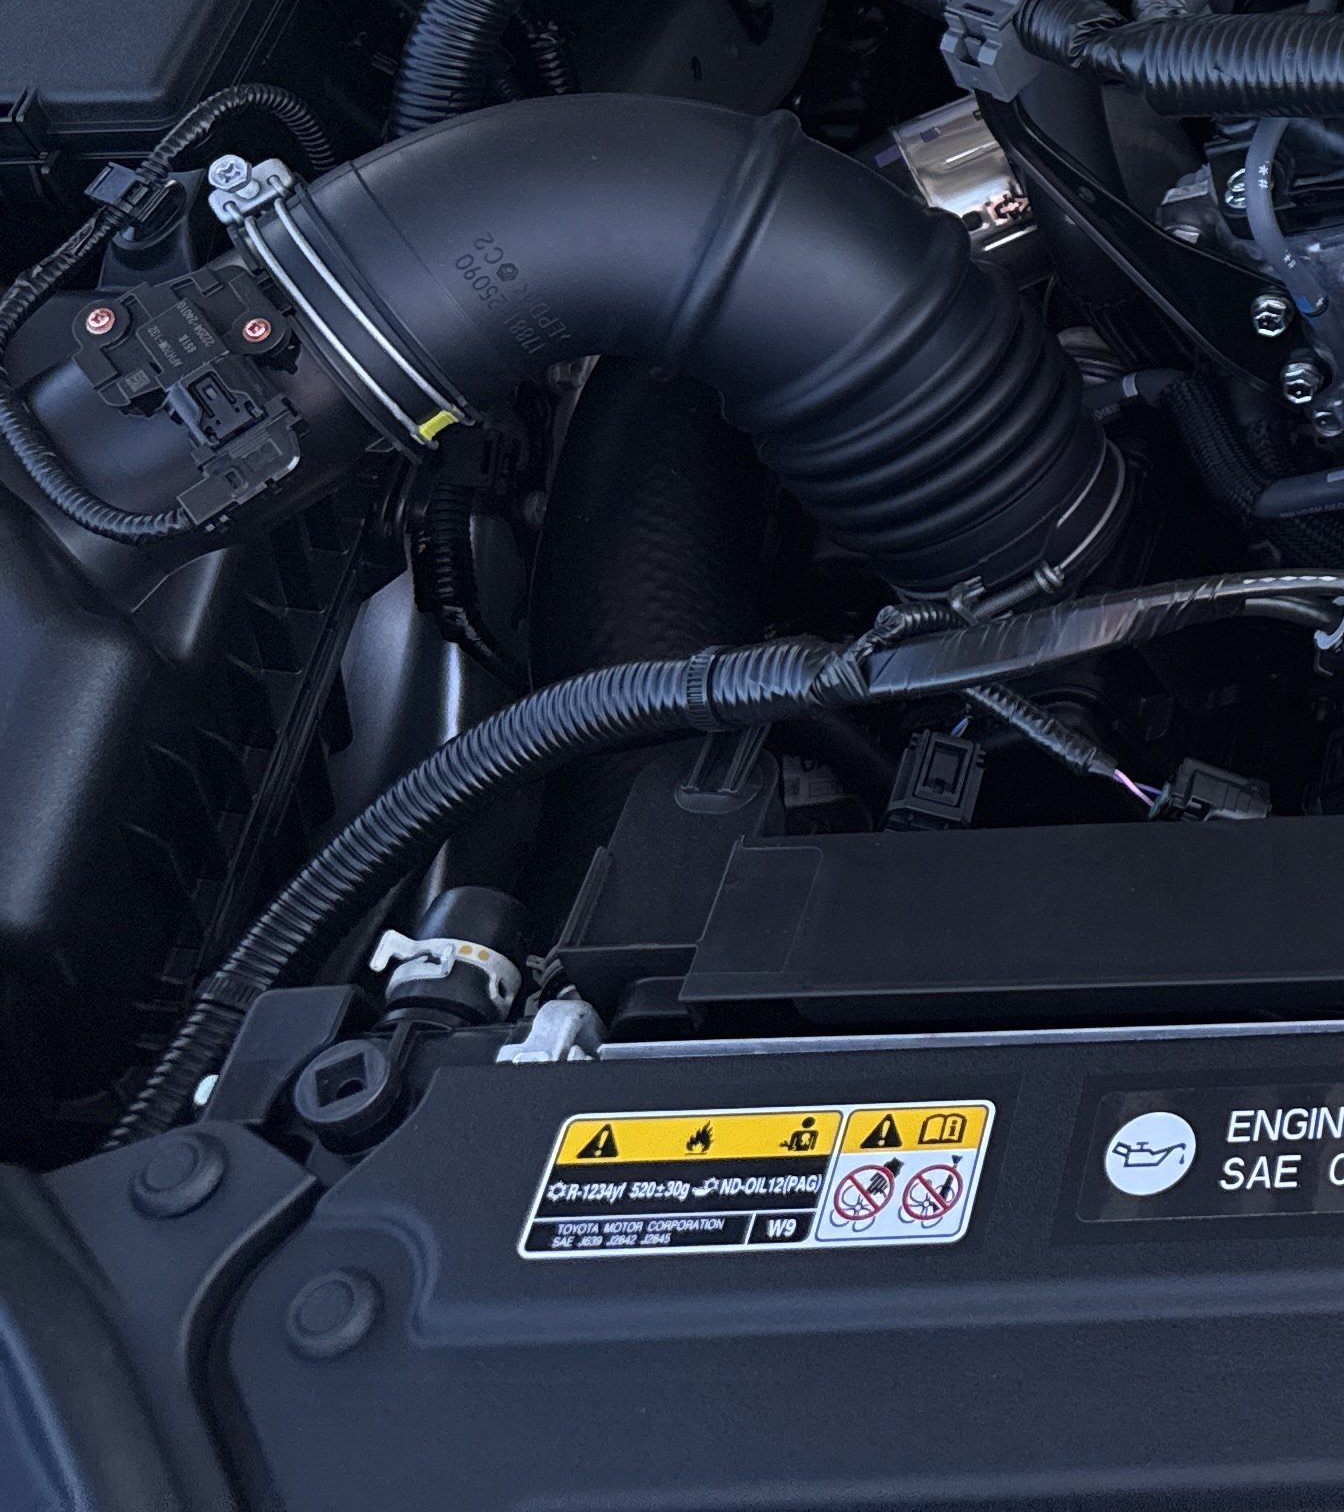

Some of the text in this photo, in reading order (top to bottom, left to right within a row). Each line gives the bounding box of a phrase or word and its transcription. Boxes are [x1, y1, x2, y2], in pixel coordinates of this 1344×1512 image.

[473, 231, 504, 266] C2
[1219, 1154, 1302, 1190] SAE
[565, 1173, 823, 1205] R-1234yf 520±30g ND-OIL12(PAG)
[557, 1218, 726, 1236] TOYOTA MOTOR CORPORATION
[767, 1218, 797, 1239] W9
[551, 1236, 575, 1249] SAE
[577, 1235, 604, 1248] J639
